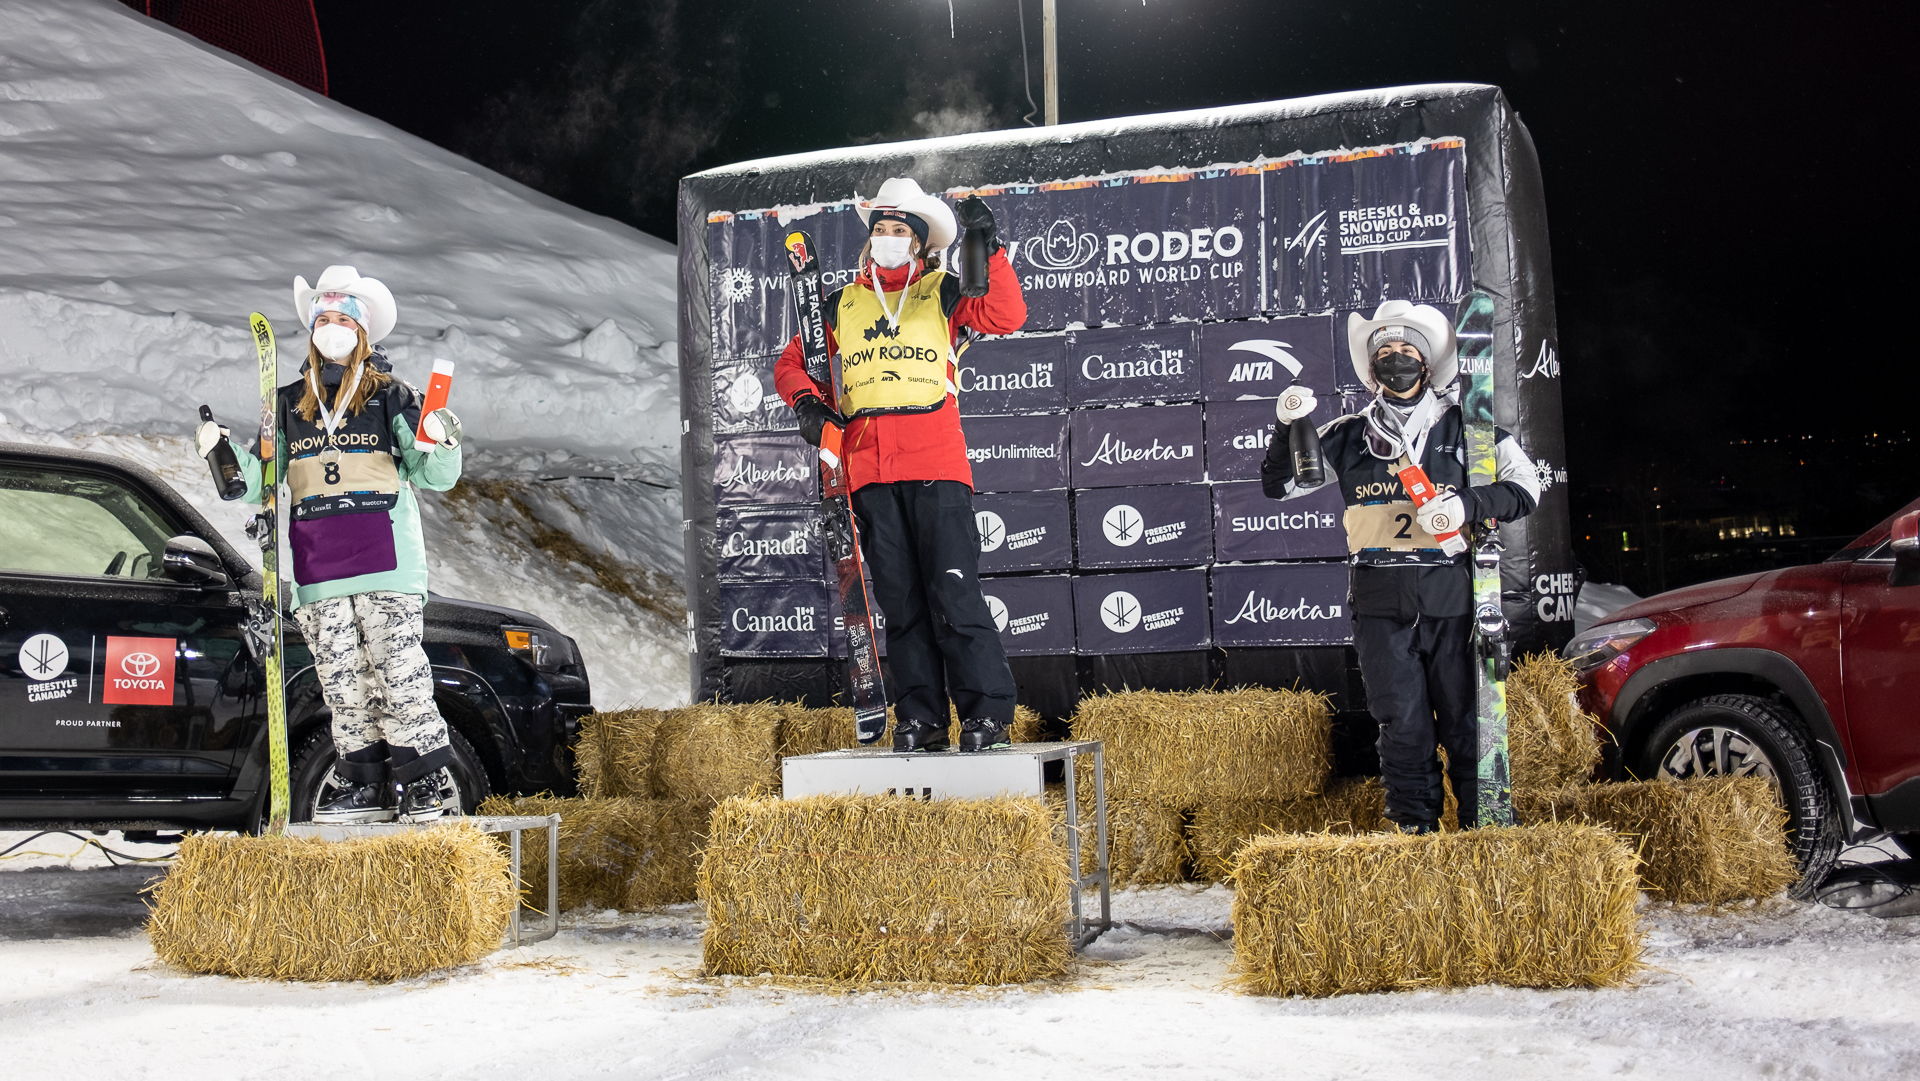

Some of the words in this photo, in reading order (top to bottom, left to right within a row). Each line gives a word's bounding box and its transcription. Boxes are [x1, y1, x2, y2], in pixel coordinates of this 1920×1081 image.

[1339, 204, 1403, 223] FREESKI
[1408, 203, 1421, 216] &
[1339, 213, 1447, 236] SNOWBOARD
[1106, 226, 1243, 266] RODEO
[1340, 234, 1385, 247] WORLD
[1386, 230, 1411, 243] CUP
[1023, 268, 1130, 292] SNOWBOARD
[1139, 264, 1201, 284] WORLD
[1210, 261, 1244, 279] CUP
[809, 293, 825, 349] FACTION
[807, 353, 828, 367] IWC
[843, 347, 875, 373] SNOW
[879, 345, 938, 363] RODEO
[1081, 349, 1185, 381] Canada
[1459, 358, 1492, 374] ZUMA
[958, 363, 1054, 392] Canada
[1228, 362, 1273, 383] ANTA
[290, 435, 326, 455] SNOW
[329, 433, 379, 446] RODEO
[965, 443, 1054, 463] lagsUnlimited
[1081, 433, 1186, 467] Alberta
[324, 462, 341, 485] 8
[720, 455, 801, 488] Alberta
[1355, 482, 1398, 499] SNOW
[1144, 521, 1187, 538] FREESTYLE
[1231, 511, 1319, 532] swatch
[1394, 513, 1413, 539] 2
[727, 530, 809, 557] Canada
[1006, 526, 1047, 542] FREESTYLE
[1008, 537, 1039, 550] CANADA
[1146, 532, 1179, 546] CANADA
[1142, 607, 1185, 624] FREESTYLE
[1224, 590, 1334, 625] Alberta
[732, 607, 816, 632] Canada
[1009, 612, 1050, 628] FREESTYLE
[1011, 623, 1042, 636] CANADA
[1144, 618, 1177, 632] CANADA
[27, 679, 78, 694] FREESTYLE
[113, 678, 166, 690] TOYOTA
[29, 690, 67, 703] CANADA
[56, 719, 84, 727] PROUD
[86, 720, 122, 728] PARTNER
